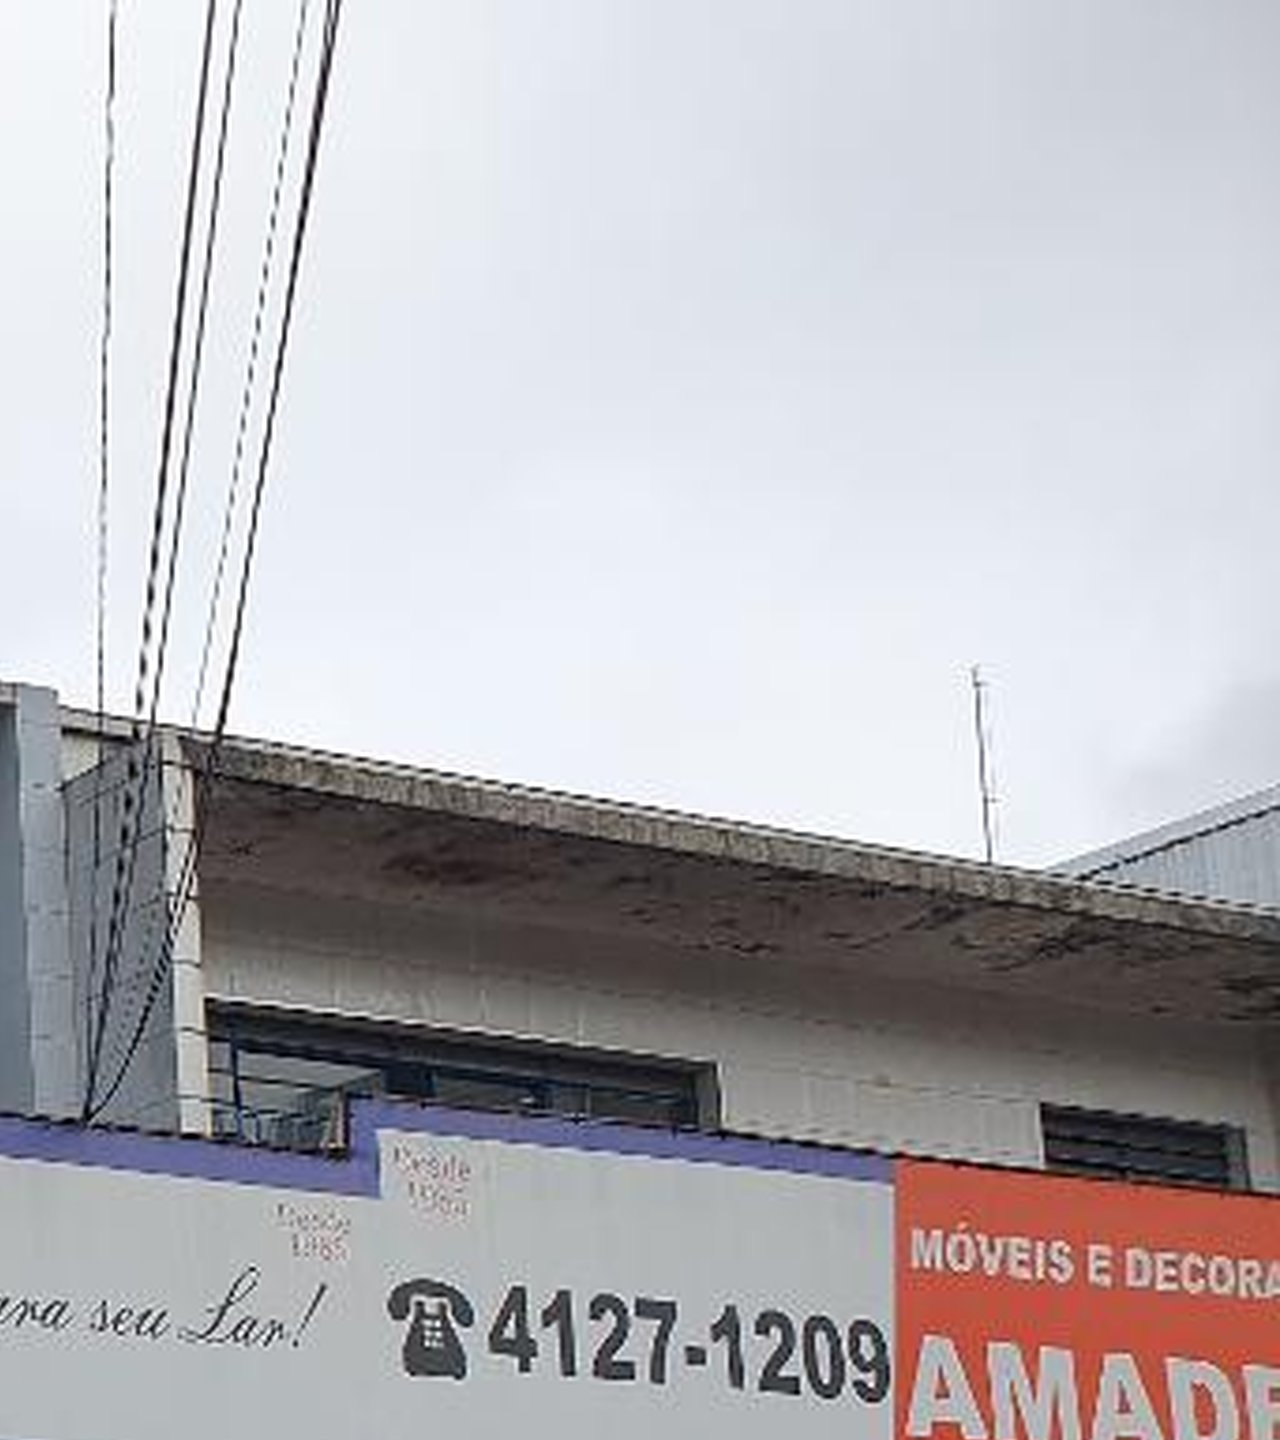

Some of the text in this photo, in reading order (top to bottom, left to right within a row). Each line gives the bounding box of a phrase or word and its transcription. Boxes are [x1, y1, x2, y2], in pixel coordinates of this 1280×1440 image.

[910, 1222, 1074, 1284] MÓVEIS
[1088, 1243, 1113, 1288] E
[88, 1302, 170, 1342] seu
[176, 1265, 328, 1350] Lar!
[488, 1284, 891, 1402] 4127-1209
